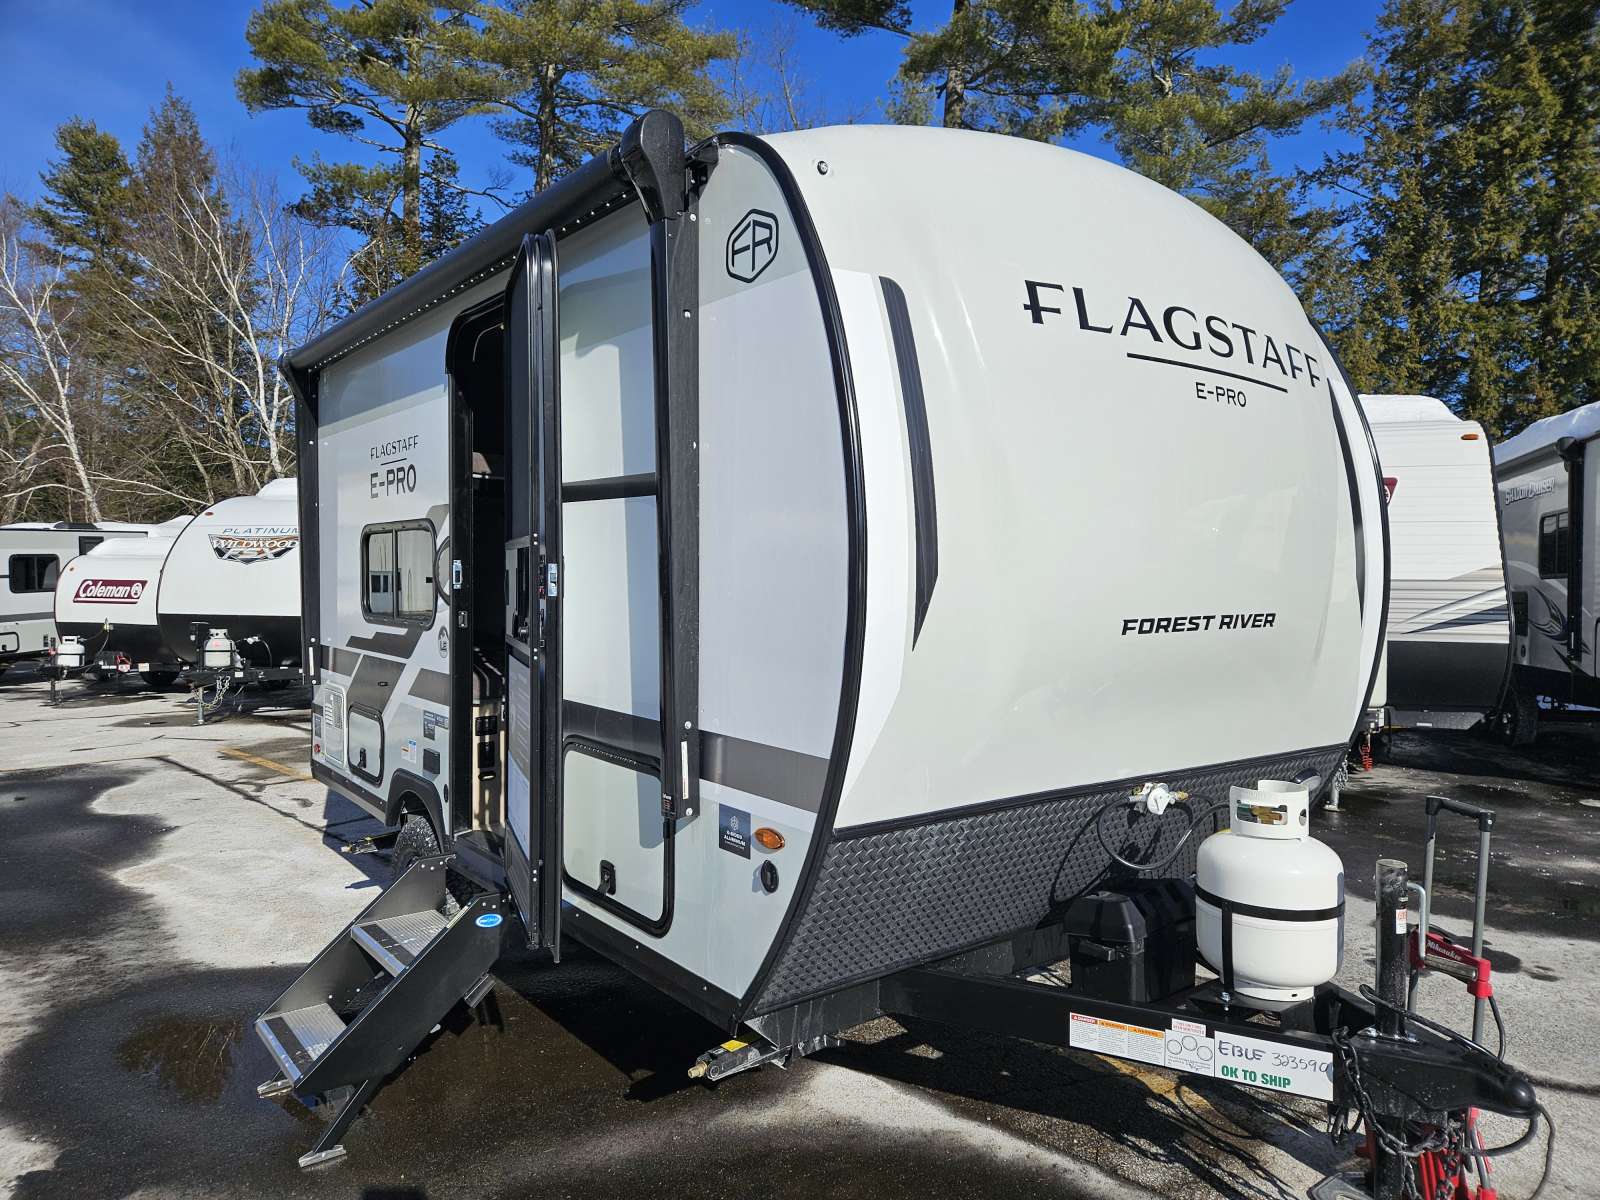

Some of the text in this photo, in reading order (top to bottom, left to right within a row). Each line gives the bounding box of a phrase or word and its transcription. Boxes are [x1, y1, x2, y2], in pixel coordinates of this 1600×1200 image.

[1023, 279, 1320, 388] FLAGSTAFF
[1195, 382, 1247, 407] E-PRO
[370, 434, 419, 460] FLAGSTAFF
[370, 464, 417, 498] E-PRO
[79, 580, 130, 598] Coleman
[1121, 612, 1277, 636] FOREST RIVER
[1221, 1065, 1291, 1089] OK TO SHIP
